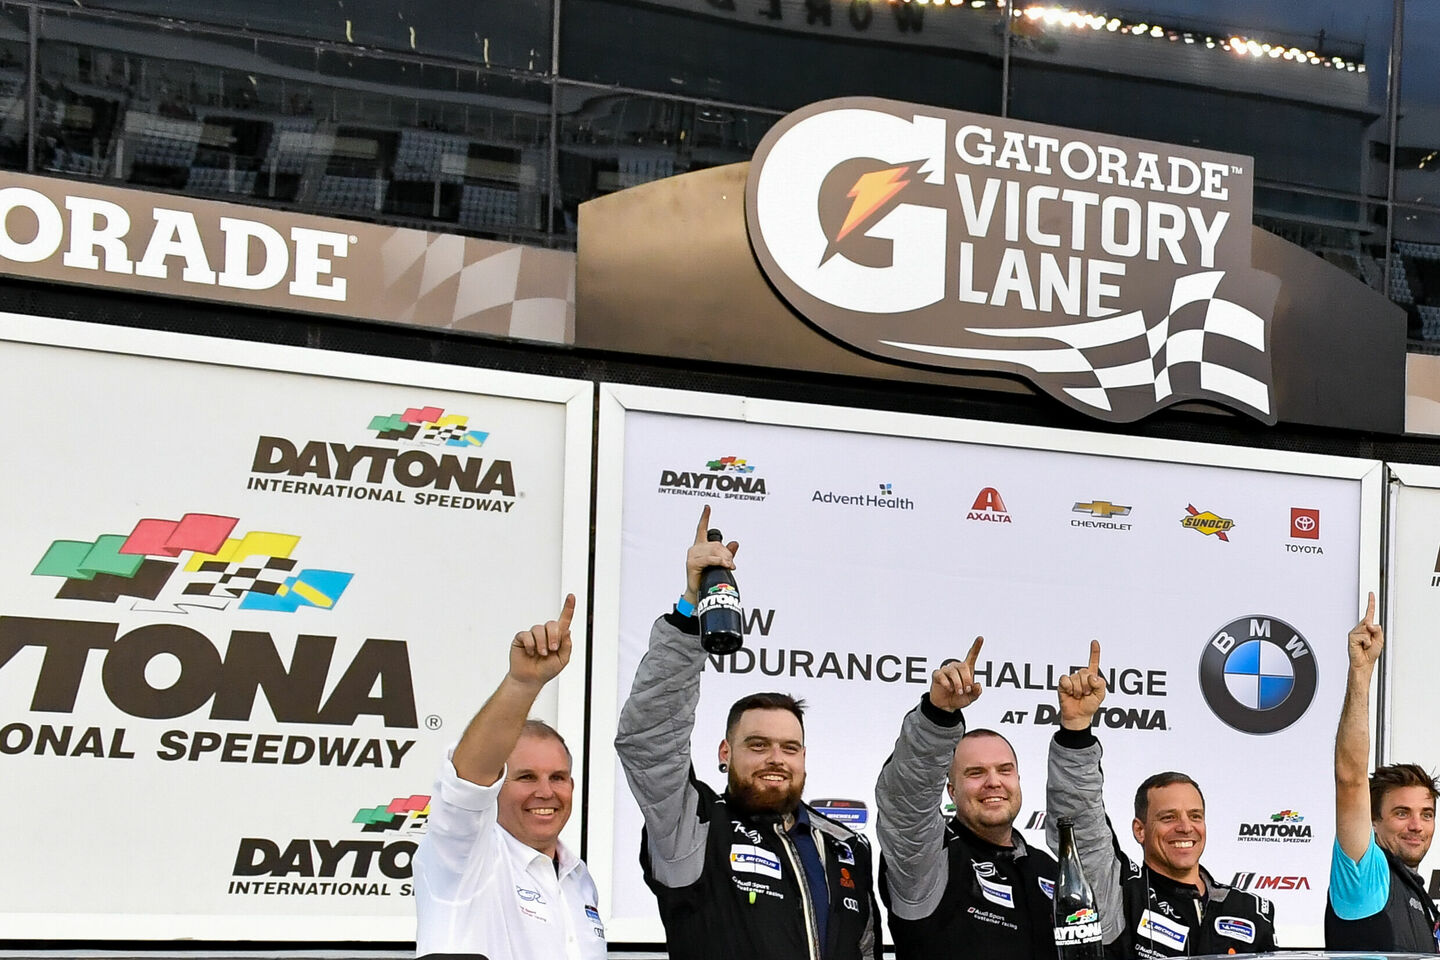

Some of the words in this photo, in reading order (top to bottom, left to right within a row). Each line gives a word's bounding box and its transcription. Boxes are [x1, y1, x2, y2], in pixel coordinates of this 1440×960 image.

[955, 125, 1229, 200] GATORADE
[954, 173, 1230, 268] VICTORY
[0, 189, 347, 301] ORADE
[959, 242, 1126, 318] LANE
[252, 436, 516, 497] DAYTONA
[247, 477, 406, 503] INTERNATIONAL
[414, 493, 515, 513] SPEEDWAY
[658, 487, 720, 501] INTERNATIONAL
[724, 493, 765, 502] SPEEDWAY
[660, 470, 766, 495] DAYTONA
[967, 511, 1012, 524] AXALTA
[1071, 519, 1132, 531] CHEVROLET
[1184, 517, 1232, 530] SUNOCO
[1285, 544, 1324, 555] TOYOTA
[1213, 619, 1309, 660] BMW
[700, 647, 927, 686] NDURANCE
[940, 658, 1167, 697] HALLNGE
[1001, 711, 1028, 724] AT
[1034, 704, 1167, 730] DATONA
[156, 730, 416, 769] SPEEDWAY
[1238, 823, 1311, 837] DAYTONA
[232, 838, 419, 879] DAYTO
[228, 881, 391, 896] INTERNATIONAL
[1255, 875, 1310, 890] IMSA
[1153, 924, 1181, 941] MICHELIN
